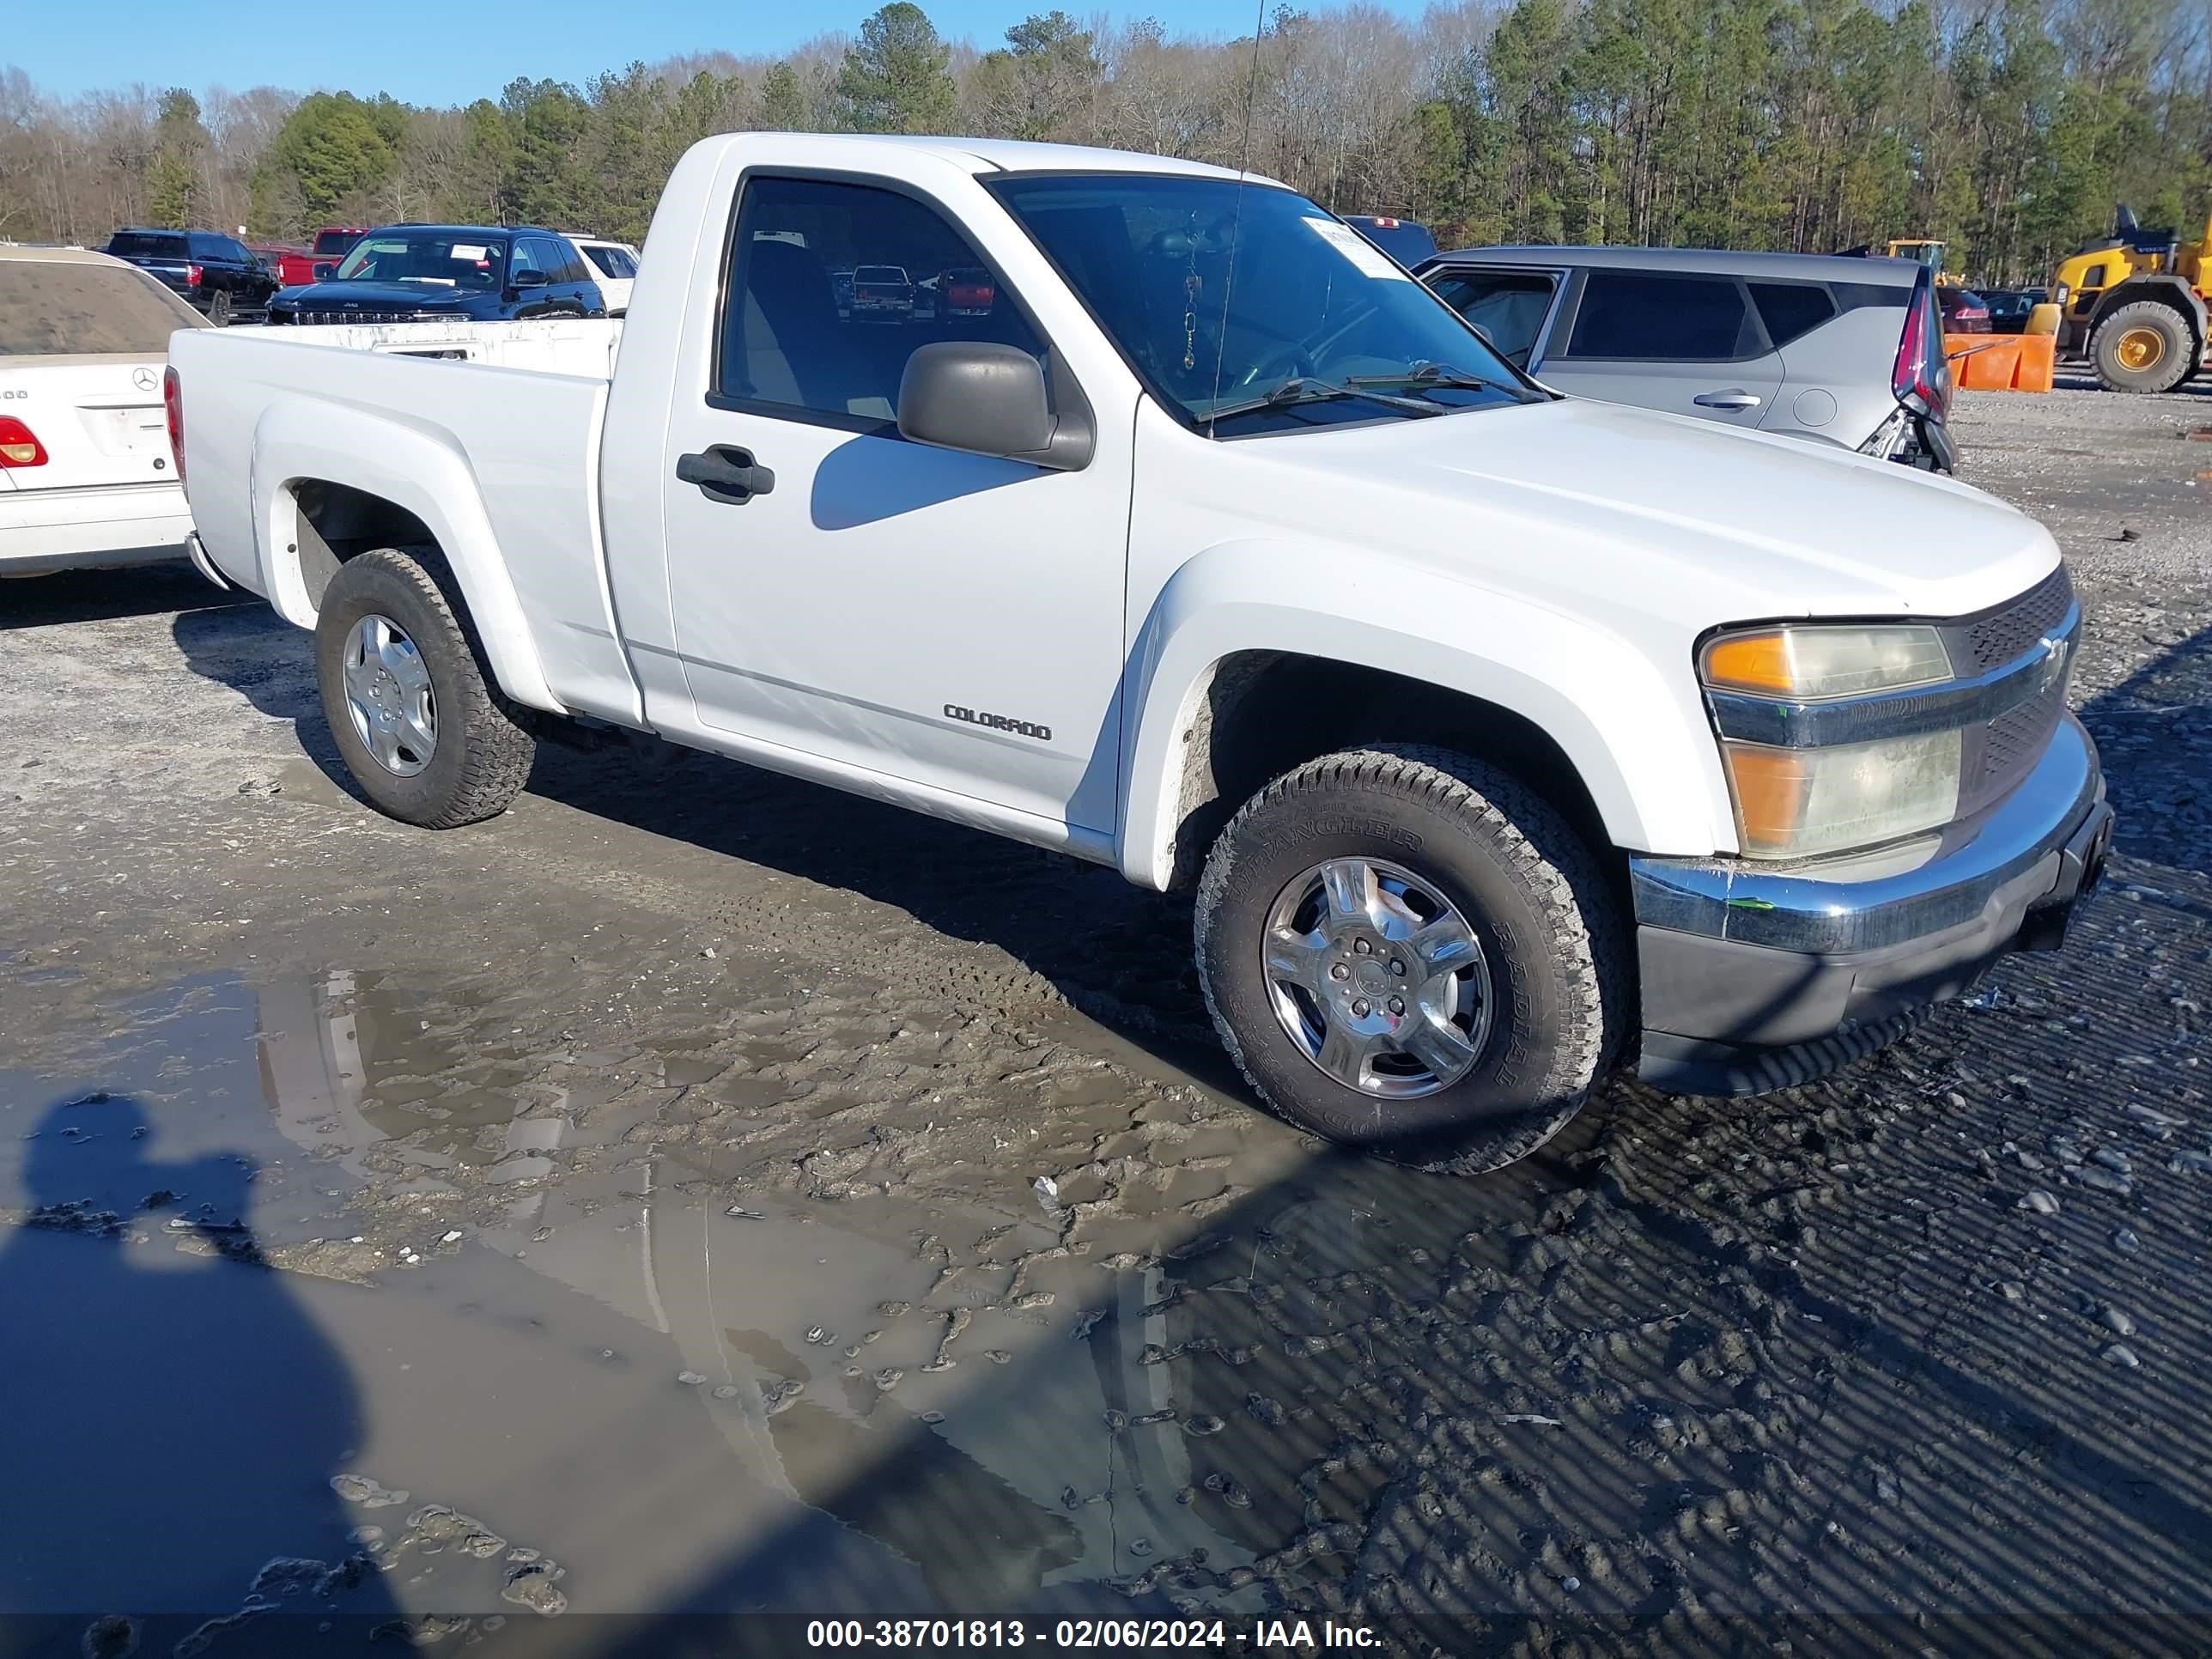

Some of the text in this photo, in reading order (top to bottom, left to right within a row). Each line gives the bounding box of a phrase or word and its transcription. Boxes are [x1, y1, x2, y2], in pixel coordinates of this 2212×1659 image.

[0, 390, 28, 399] 00
[943, 703, 1053, 741] COLORADO
[1228, 816, 1425, 904] WRANGLER
[1490, 921, 1533, 1087] RADIAL
